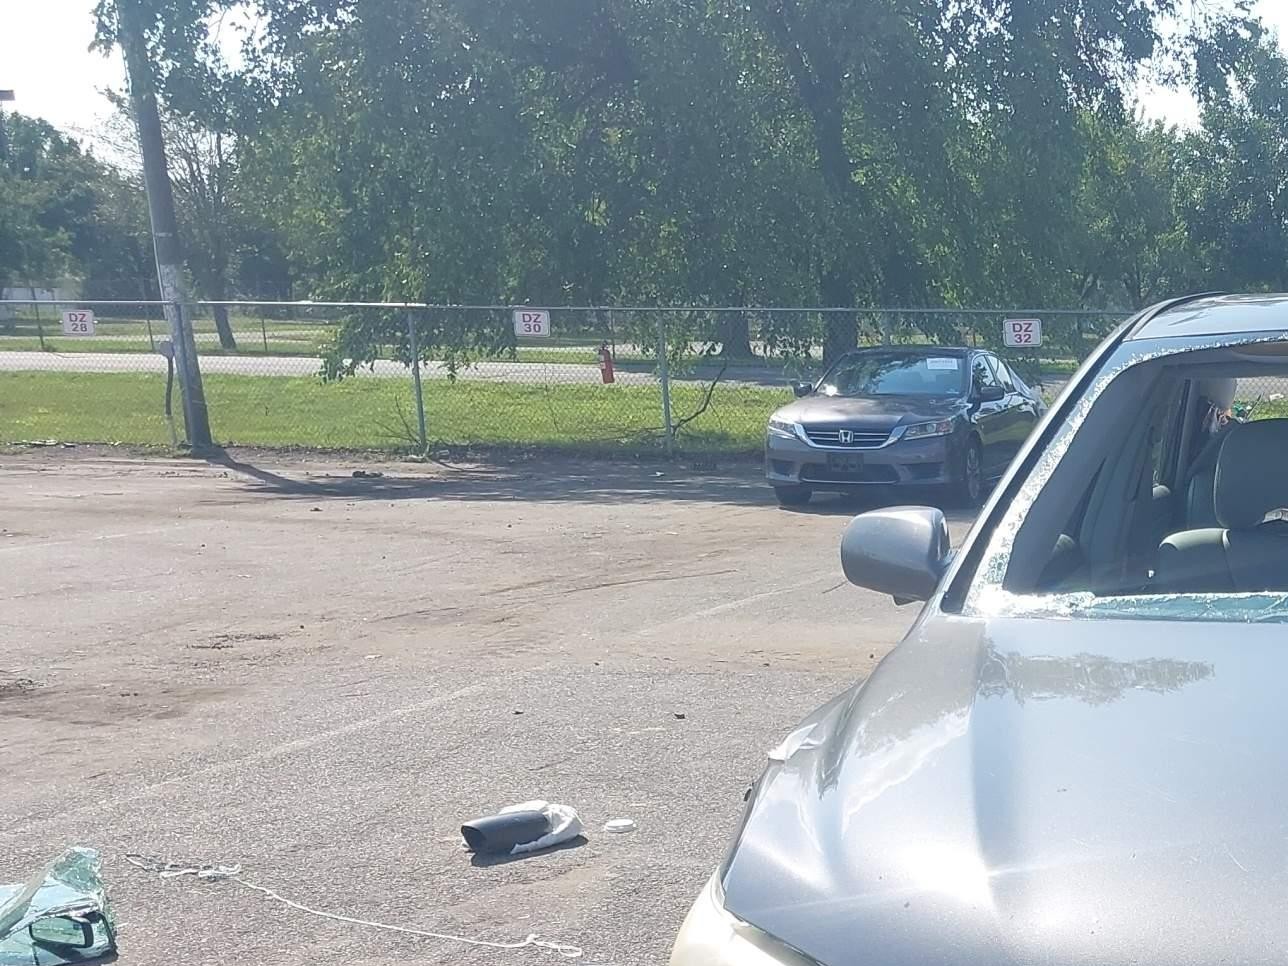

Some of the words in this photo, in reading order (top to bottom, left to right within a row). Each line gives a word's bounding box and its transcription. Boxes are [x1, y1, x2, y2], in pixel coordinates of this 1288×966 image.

[69, 313, 87, 322] DZ
[522, 313, 542, 323] DZ
[71, 323, 87, 332] 28
[524, 324, 541, 333] 30
[1012, 322, 1033, 333] DZ
[1014, 334, 1031, 343] 32
